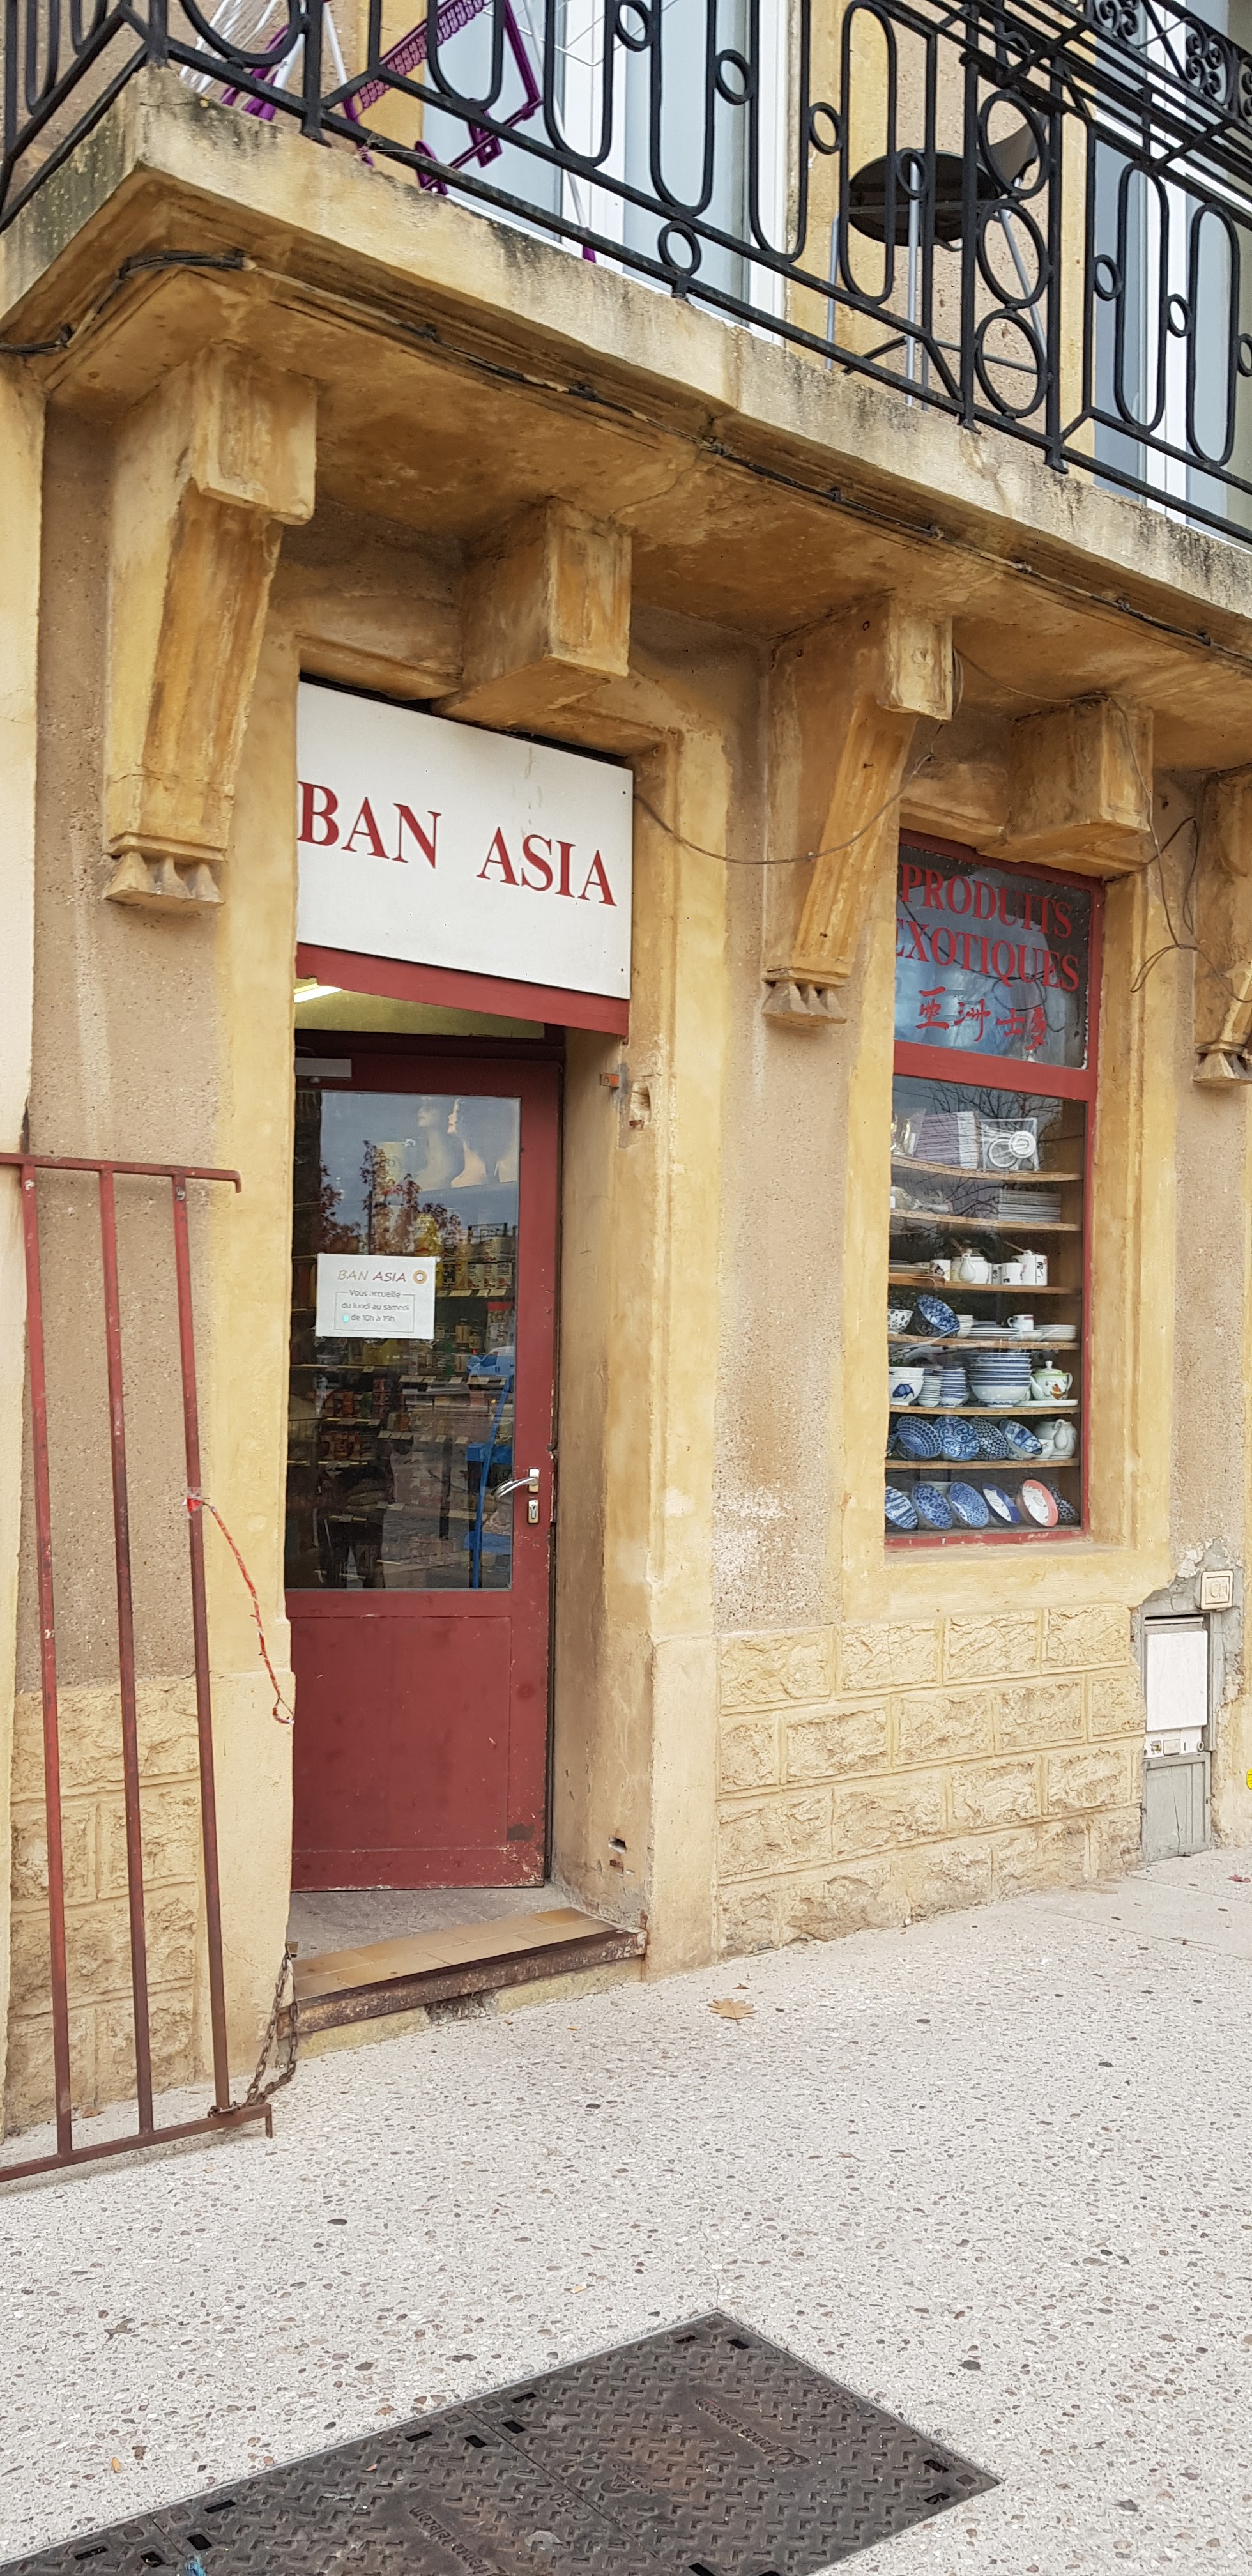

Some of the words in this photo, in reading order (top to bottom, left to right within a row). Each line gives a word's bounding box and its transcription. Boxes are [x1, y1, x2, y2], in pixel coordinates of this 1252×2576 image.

[297, 781, 442, 869] BAN
[476, 826, 618, 907] ASIA
[899, 862, 1072, 939] PRODUITS
[896, 918, 1080, 992] EXOTIQUES
[337, 1269, 369, 1281] BAN
[372, 1271, 406, 1282] ASIA
[369, 1290, 401, 1298] accueille
